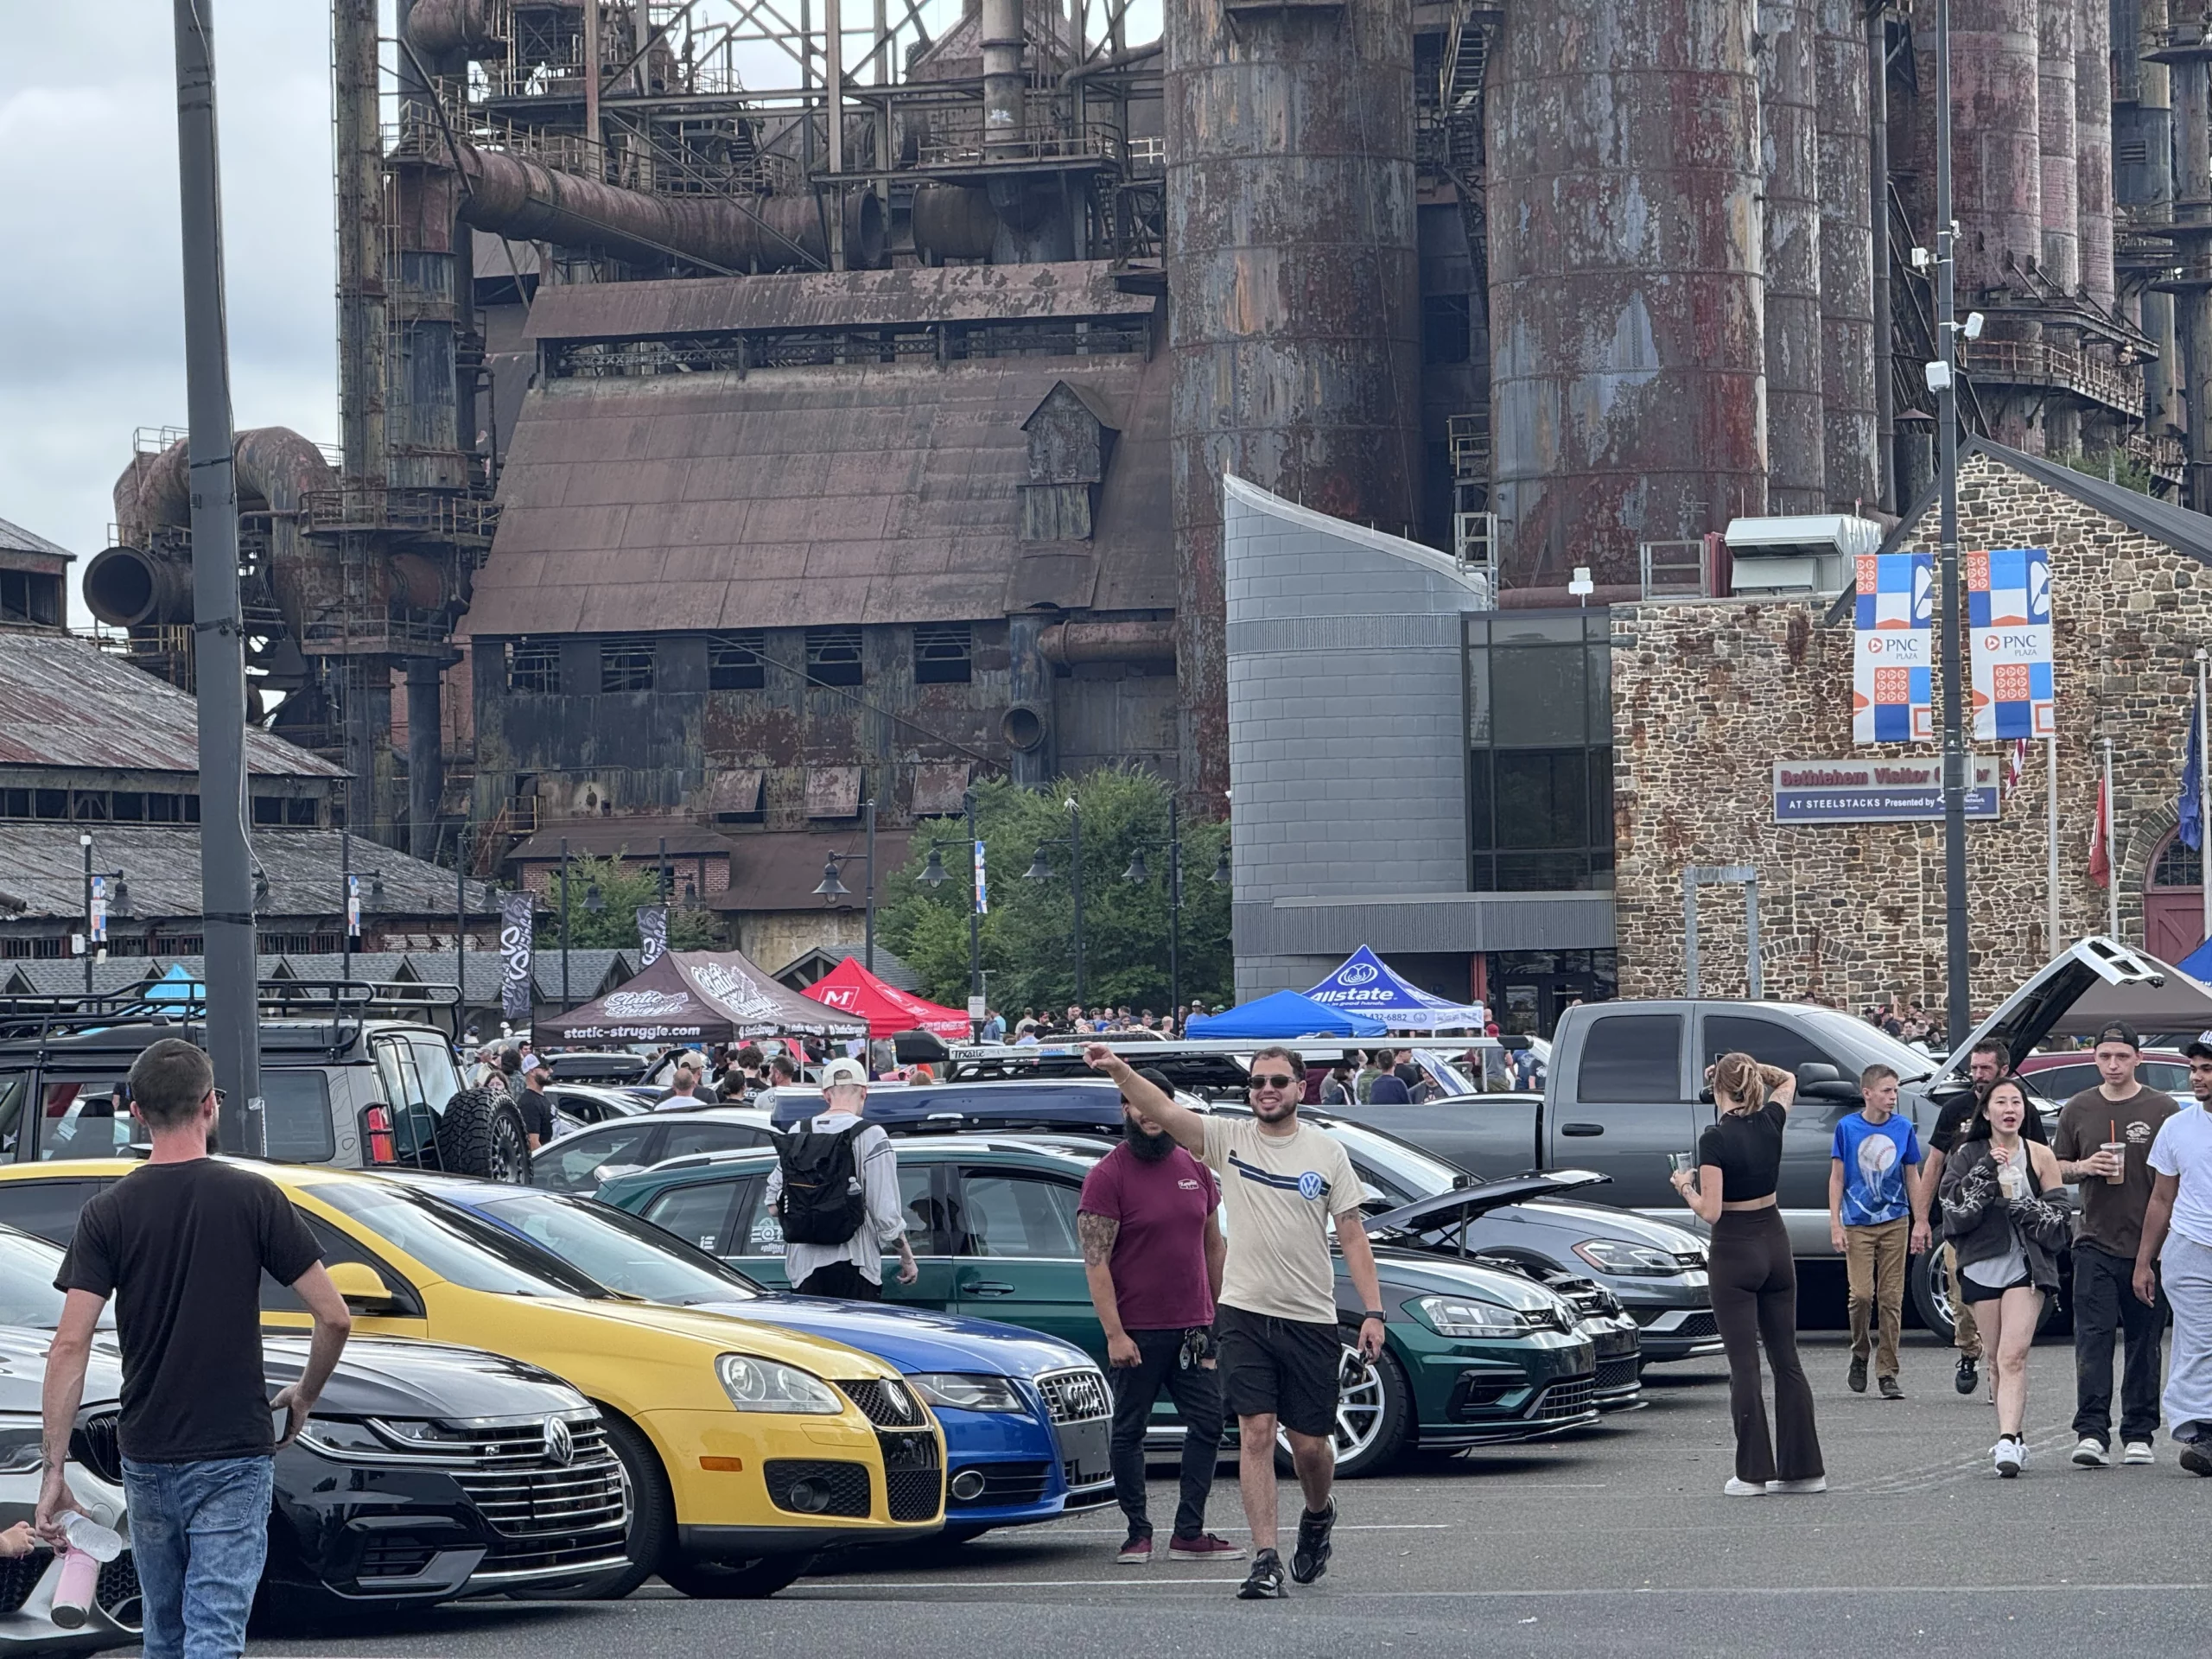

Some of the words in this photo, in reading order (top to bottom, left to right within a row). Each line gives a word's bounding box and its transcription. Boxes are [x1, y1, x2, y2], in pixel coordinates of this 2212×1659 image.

[1885, 639, 1918, 652] PNC
[2003, 634, 2037, 649] PNC
[1780, 769, 1869, 787] Bethlehem
[1873, 767, 1930, 785] Visitor
[1789, 799, 1802, 810] AT
[1806, 798, 1881, 809] STEELSTACKS
[1885, 798, 1924, 808] Presented
[1925, 798, 1936, 809] by
[1310, 988, 1394, 1003] Allstate
[563, 1026, 702, 1040] static-struggle.com
